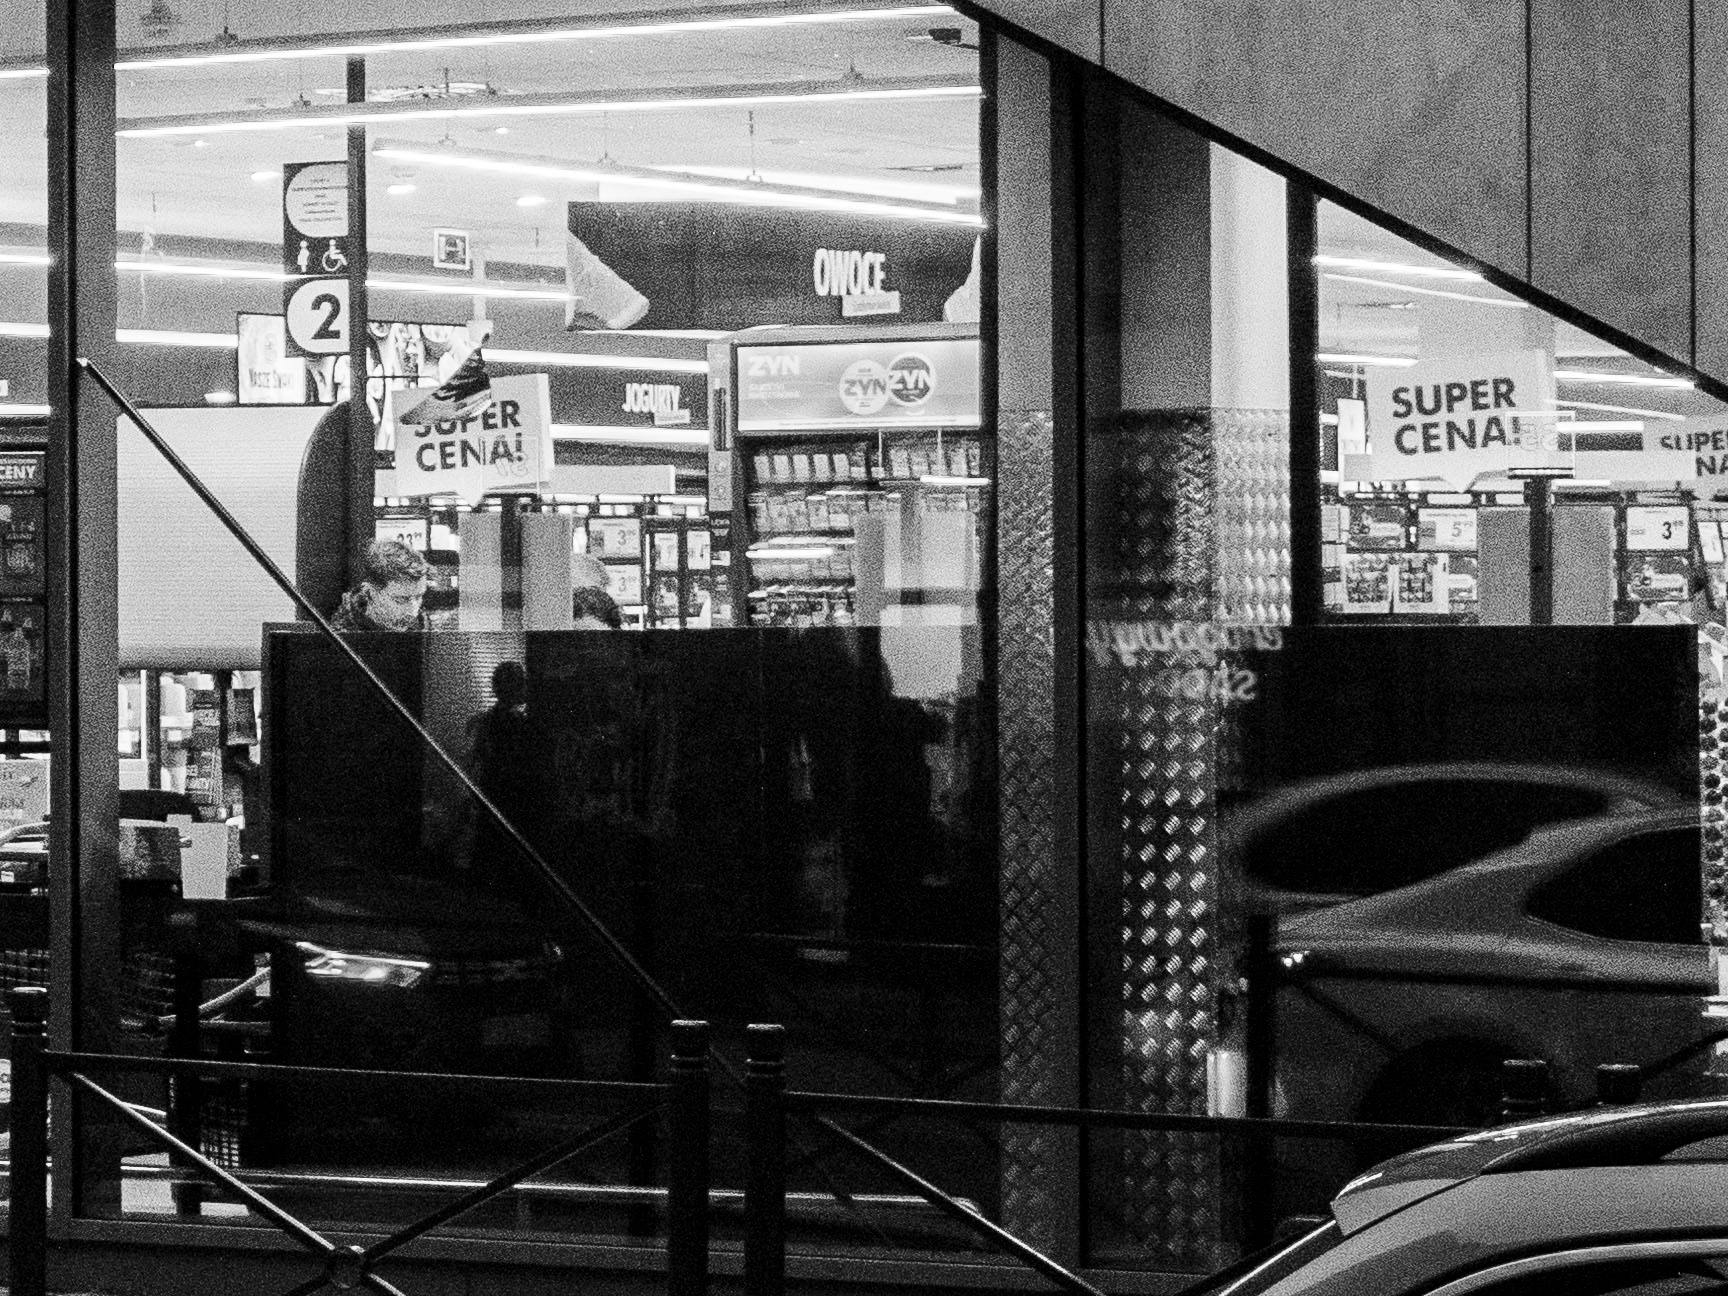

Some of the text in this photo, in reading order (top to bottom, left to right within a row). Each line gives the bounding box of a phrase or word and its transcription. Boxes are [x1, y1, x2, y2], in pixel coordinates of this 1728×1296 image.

[813, 248, 886, 298] OWOCE
[310, 292, 342, 341] 2
[747, 355, 801, 377] ZYN
[888, 369, 932, 391] ZYN
[843, 379, 888, 397] ZYN
[1392, 377, 1517, 420] SUPER
[415, 432, 524, 472] CENA!
[1393, 416, 1523, 455] CENA!
